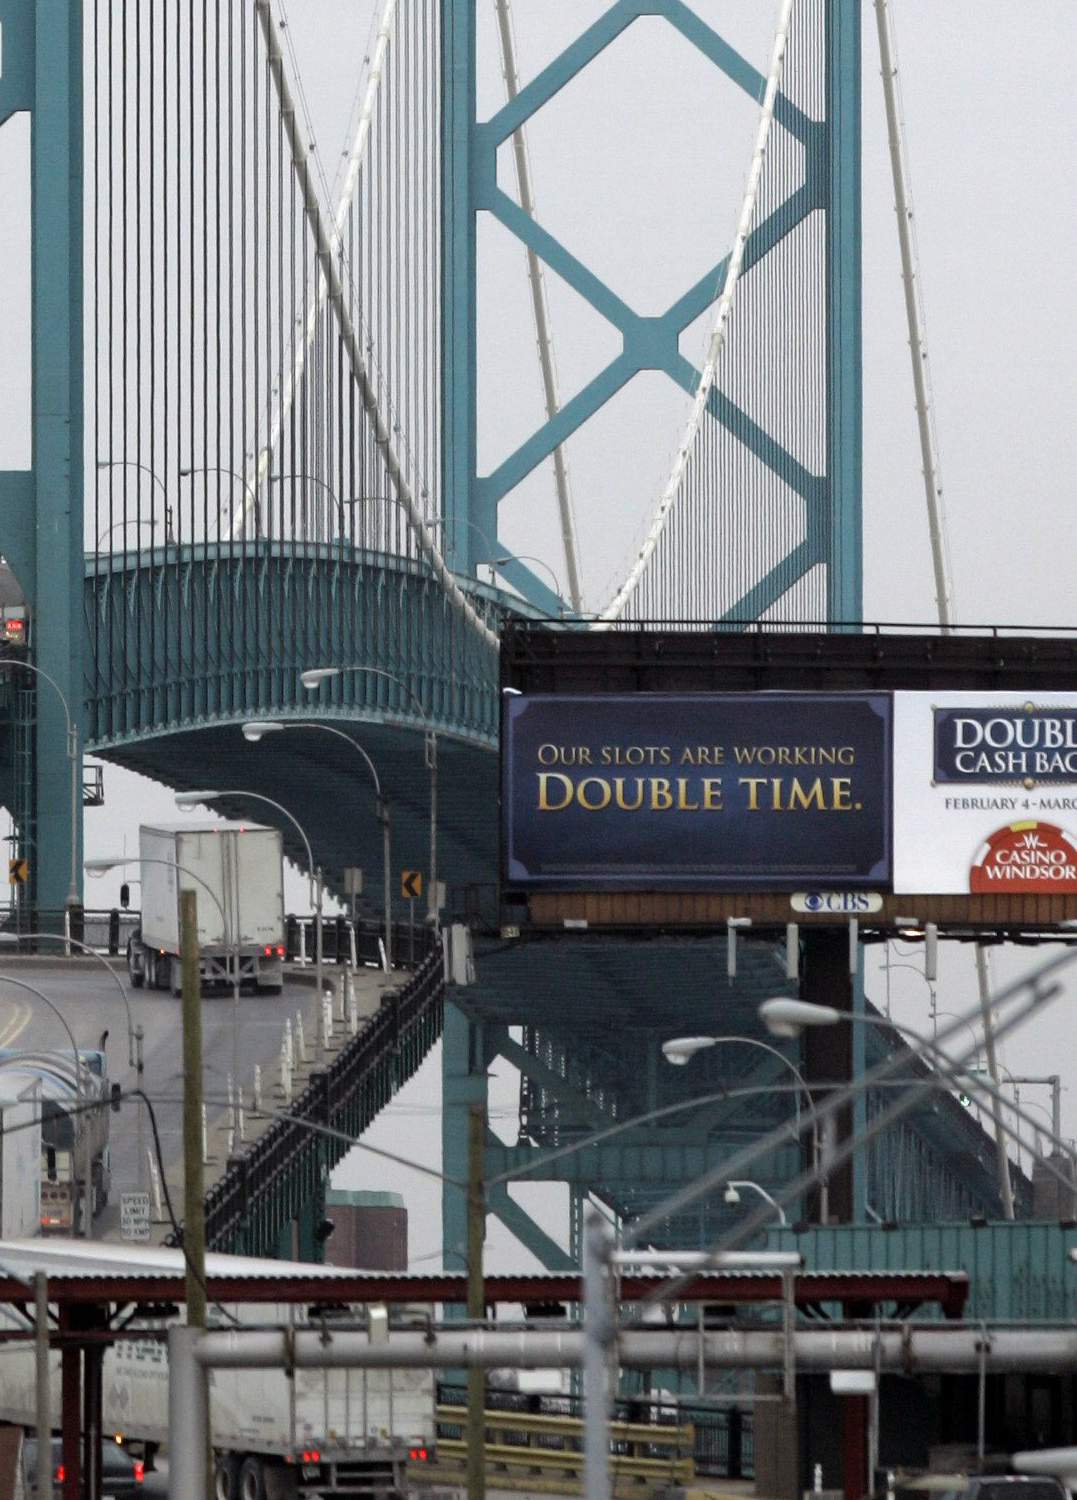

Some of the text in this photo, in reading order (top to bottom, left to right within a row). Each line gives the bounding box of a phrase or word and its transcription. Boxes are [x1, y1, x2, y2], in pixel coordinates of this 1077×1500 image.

[537, 744, 856, 766] OUR SLOTS ARE WORKING
[955, 751, 1027, 774] CASH
[535, 773, 862, 811] DOUBLE TIME.
[945, 798, 1017, 810] FEBRUARY
[996, 850, 1067, 865] CASINO
[985, 865, 1077, 880] WINDSOR
[826, 892, 869, 912] CBS
[122, 1196, 149, 1205] SPEED
[124, 1207, 145, 1215] LIMIT
